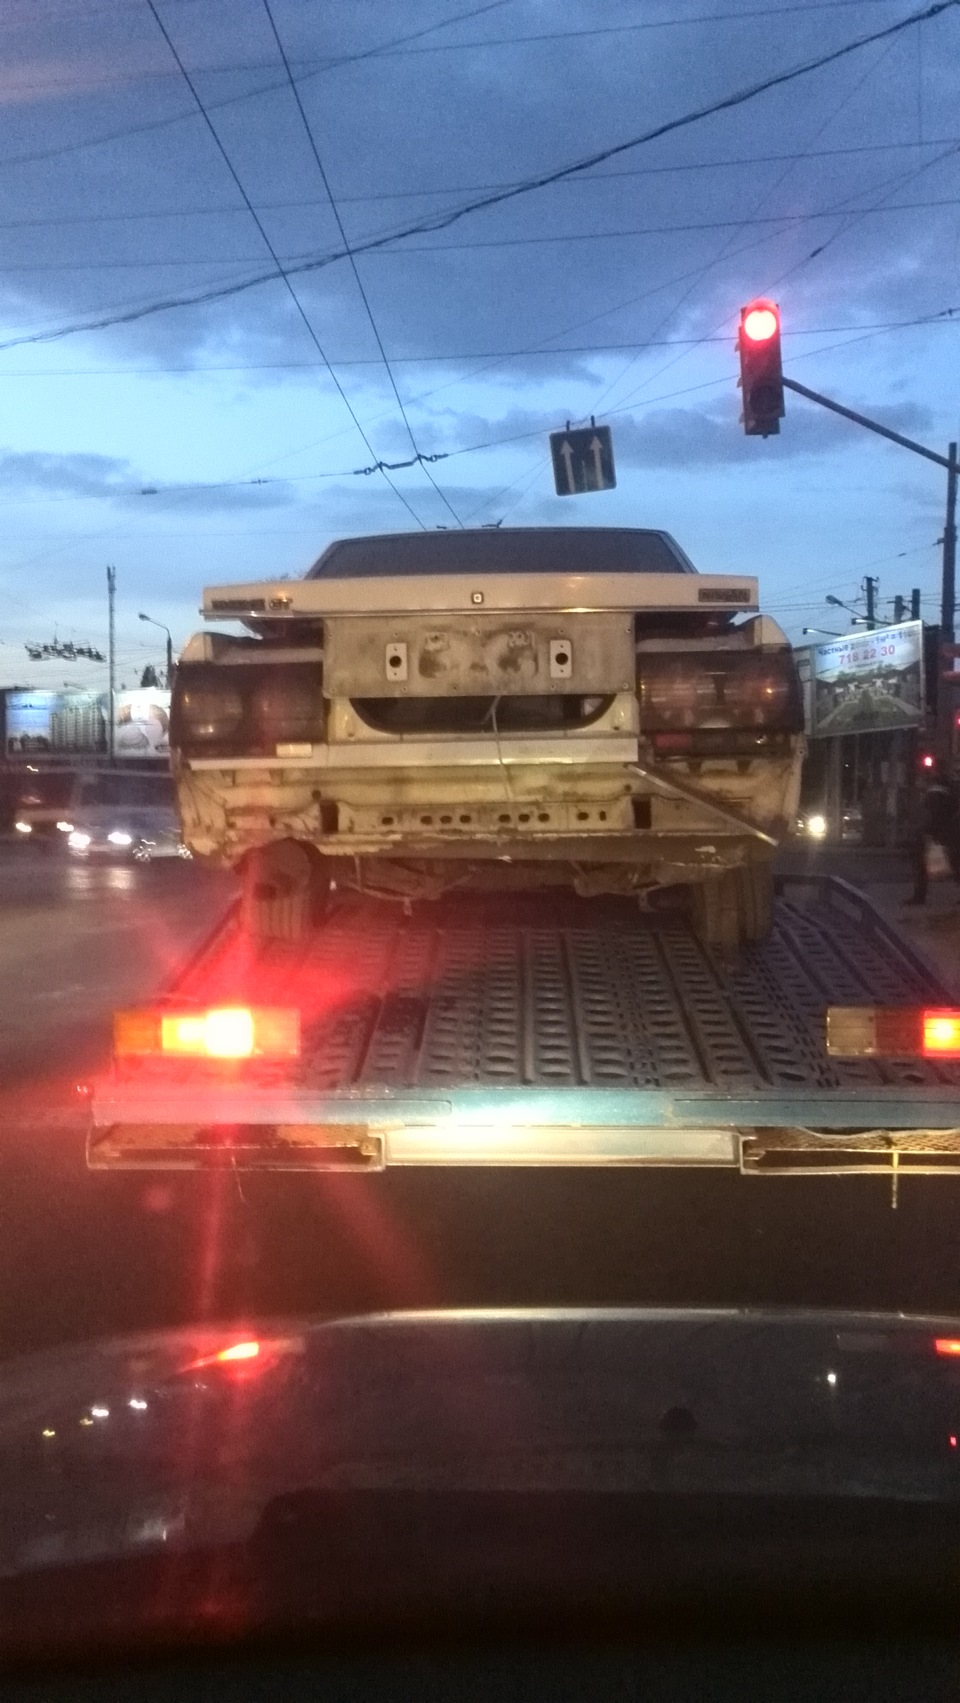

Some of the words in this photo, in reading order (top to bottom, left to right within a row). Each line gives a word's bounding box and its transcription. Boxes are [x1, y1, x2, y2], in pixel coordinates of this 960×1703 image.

[838, 652, 859, 664] 718
[863, 648, 877, 660] 22
[881, 644, 896, 656] 30
